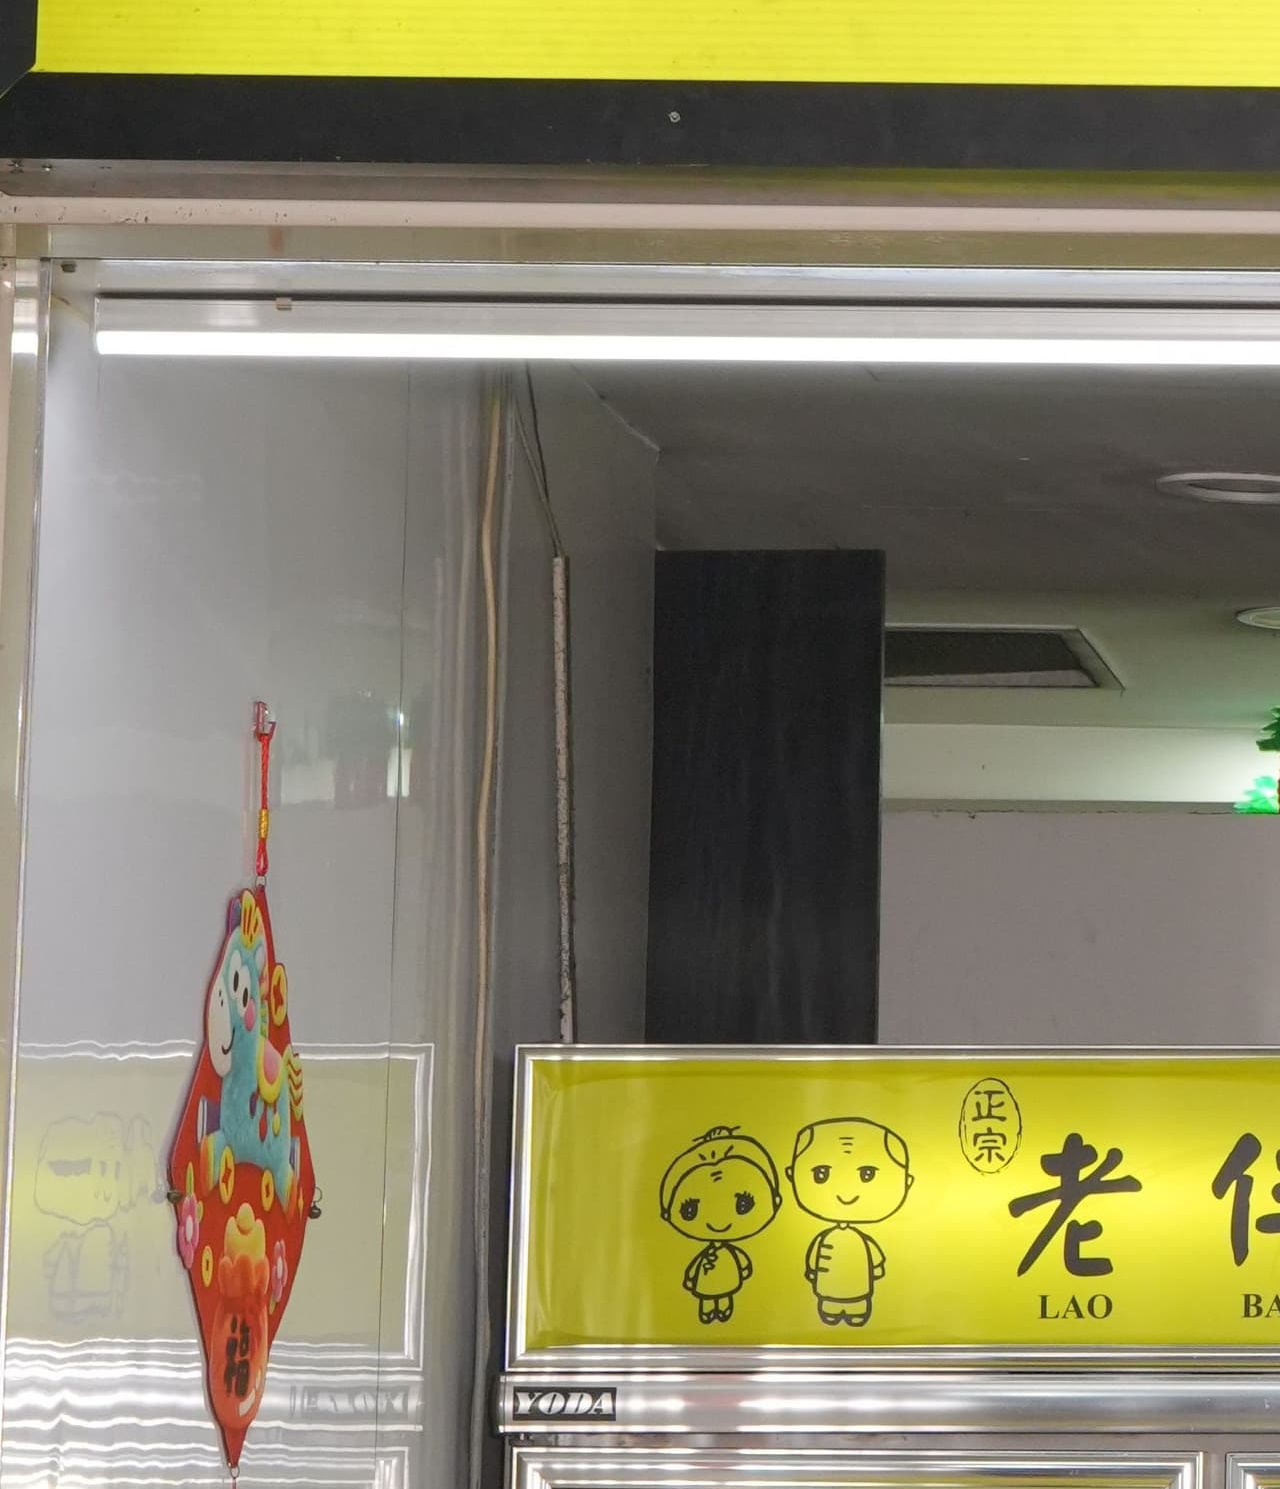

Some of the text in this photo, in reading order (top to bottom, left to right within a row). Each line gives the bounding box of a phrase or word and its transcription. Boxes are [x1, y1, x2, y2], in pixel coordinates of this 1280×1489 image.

[971, 1090, 1007, 1163] 正宗
[1039, 1294, 1113, 1319] LAO
[515, 1391, 614, 1415] YODA
